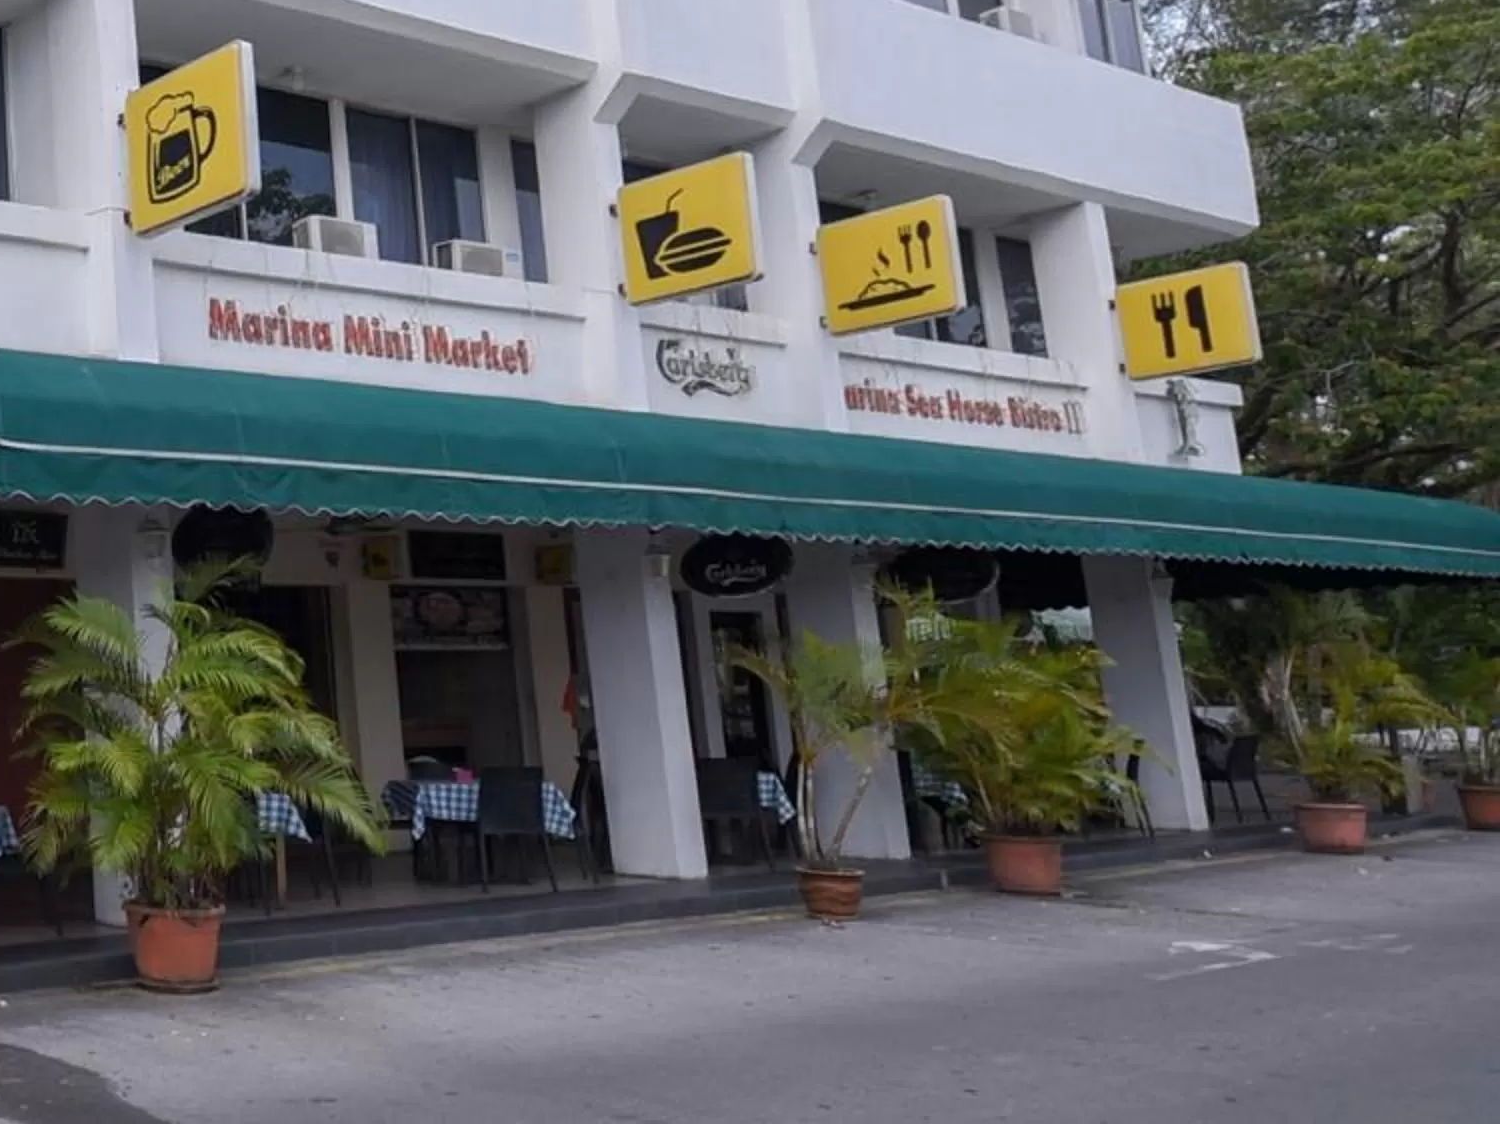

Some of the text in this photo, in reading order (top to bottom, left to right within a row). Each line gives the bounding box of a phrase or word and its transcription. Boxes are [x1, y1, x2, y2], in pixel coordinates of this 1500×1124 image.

[208, 296, 531, 375] Marina Mini Market
[655, 339, 757, 397] Carlsberg
[904, 383, 944, 420] Sea
[946, 389, 1004, 427] Horse
[1007, 395, 1062, 432] Bistro
